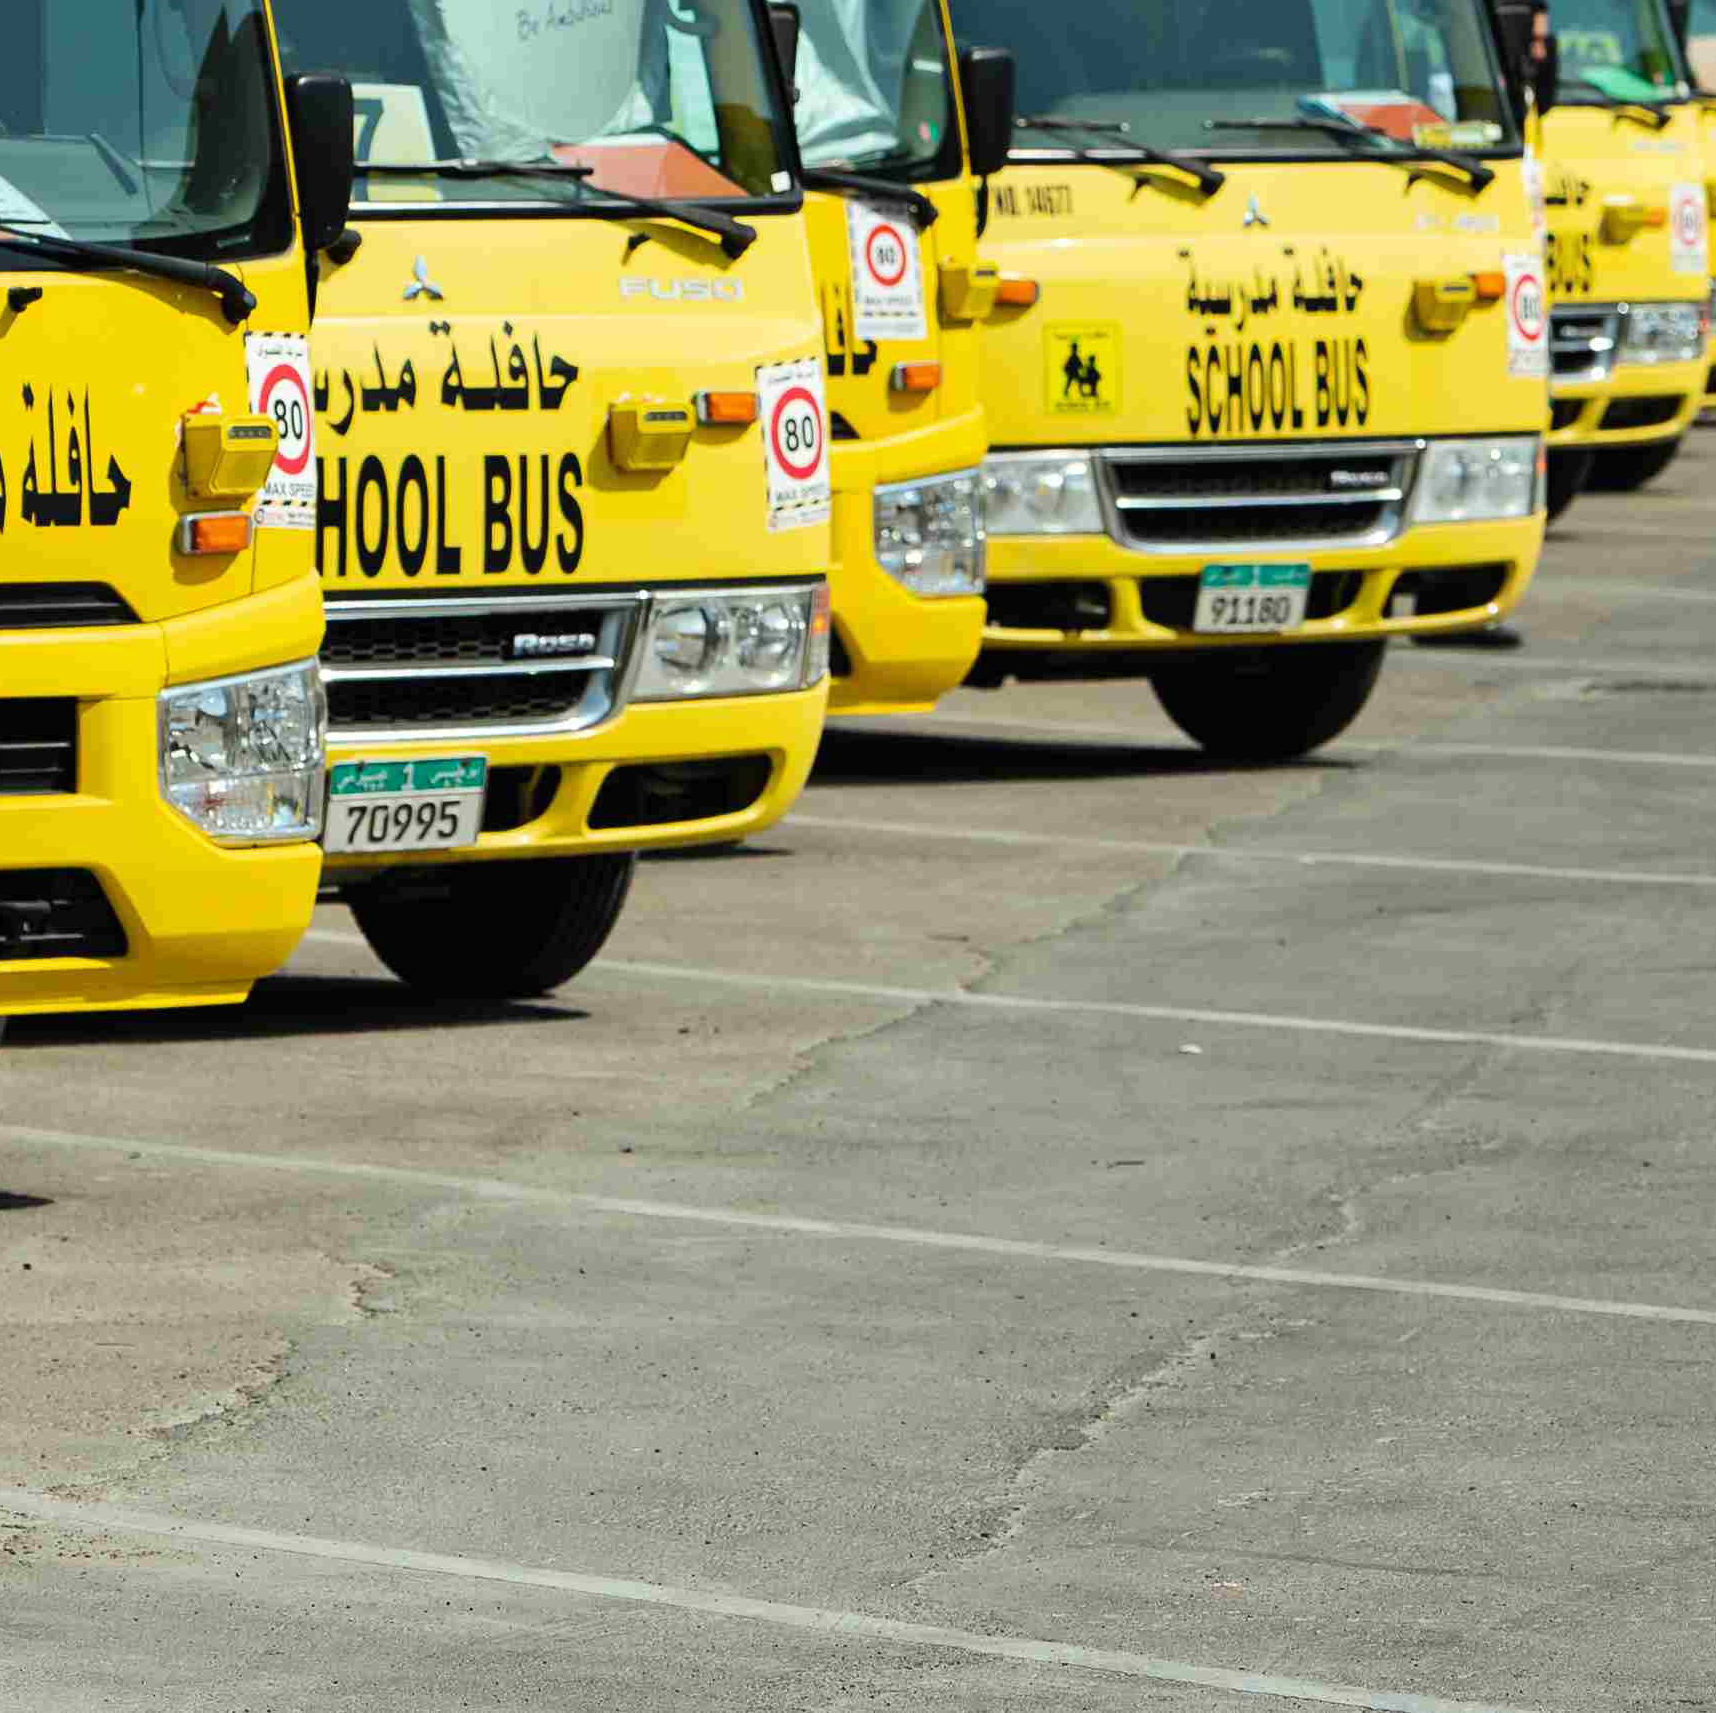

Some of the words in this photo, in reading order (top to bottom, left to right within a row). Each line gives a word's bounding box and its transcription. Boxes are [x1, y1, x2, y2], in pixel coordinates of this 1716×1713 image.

[429, 320, 579, 411] حافلة
[1187, 342, 1303, 434] SCHOOL
[1316, 338, 1369, 428] BUS
[21, 383, 131, 527] حافلة
[274, 399, 303, 440] 80
[785, 415, 814, 452] 80
[484, 452, 583, 575] BUS
[347, 800, 461, 845] 70995
